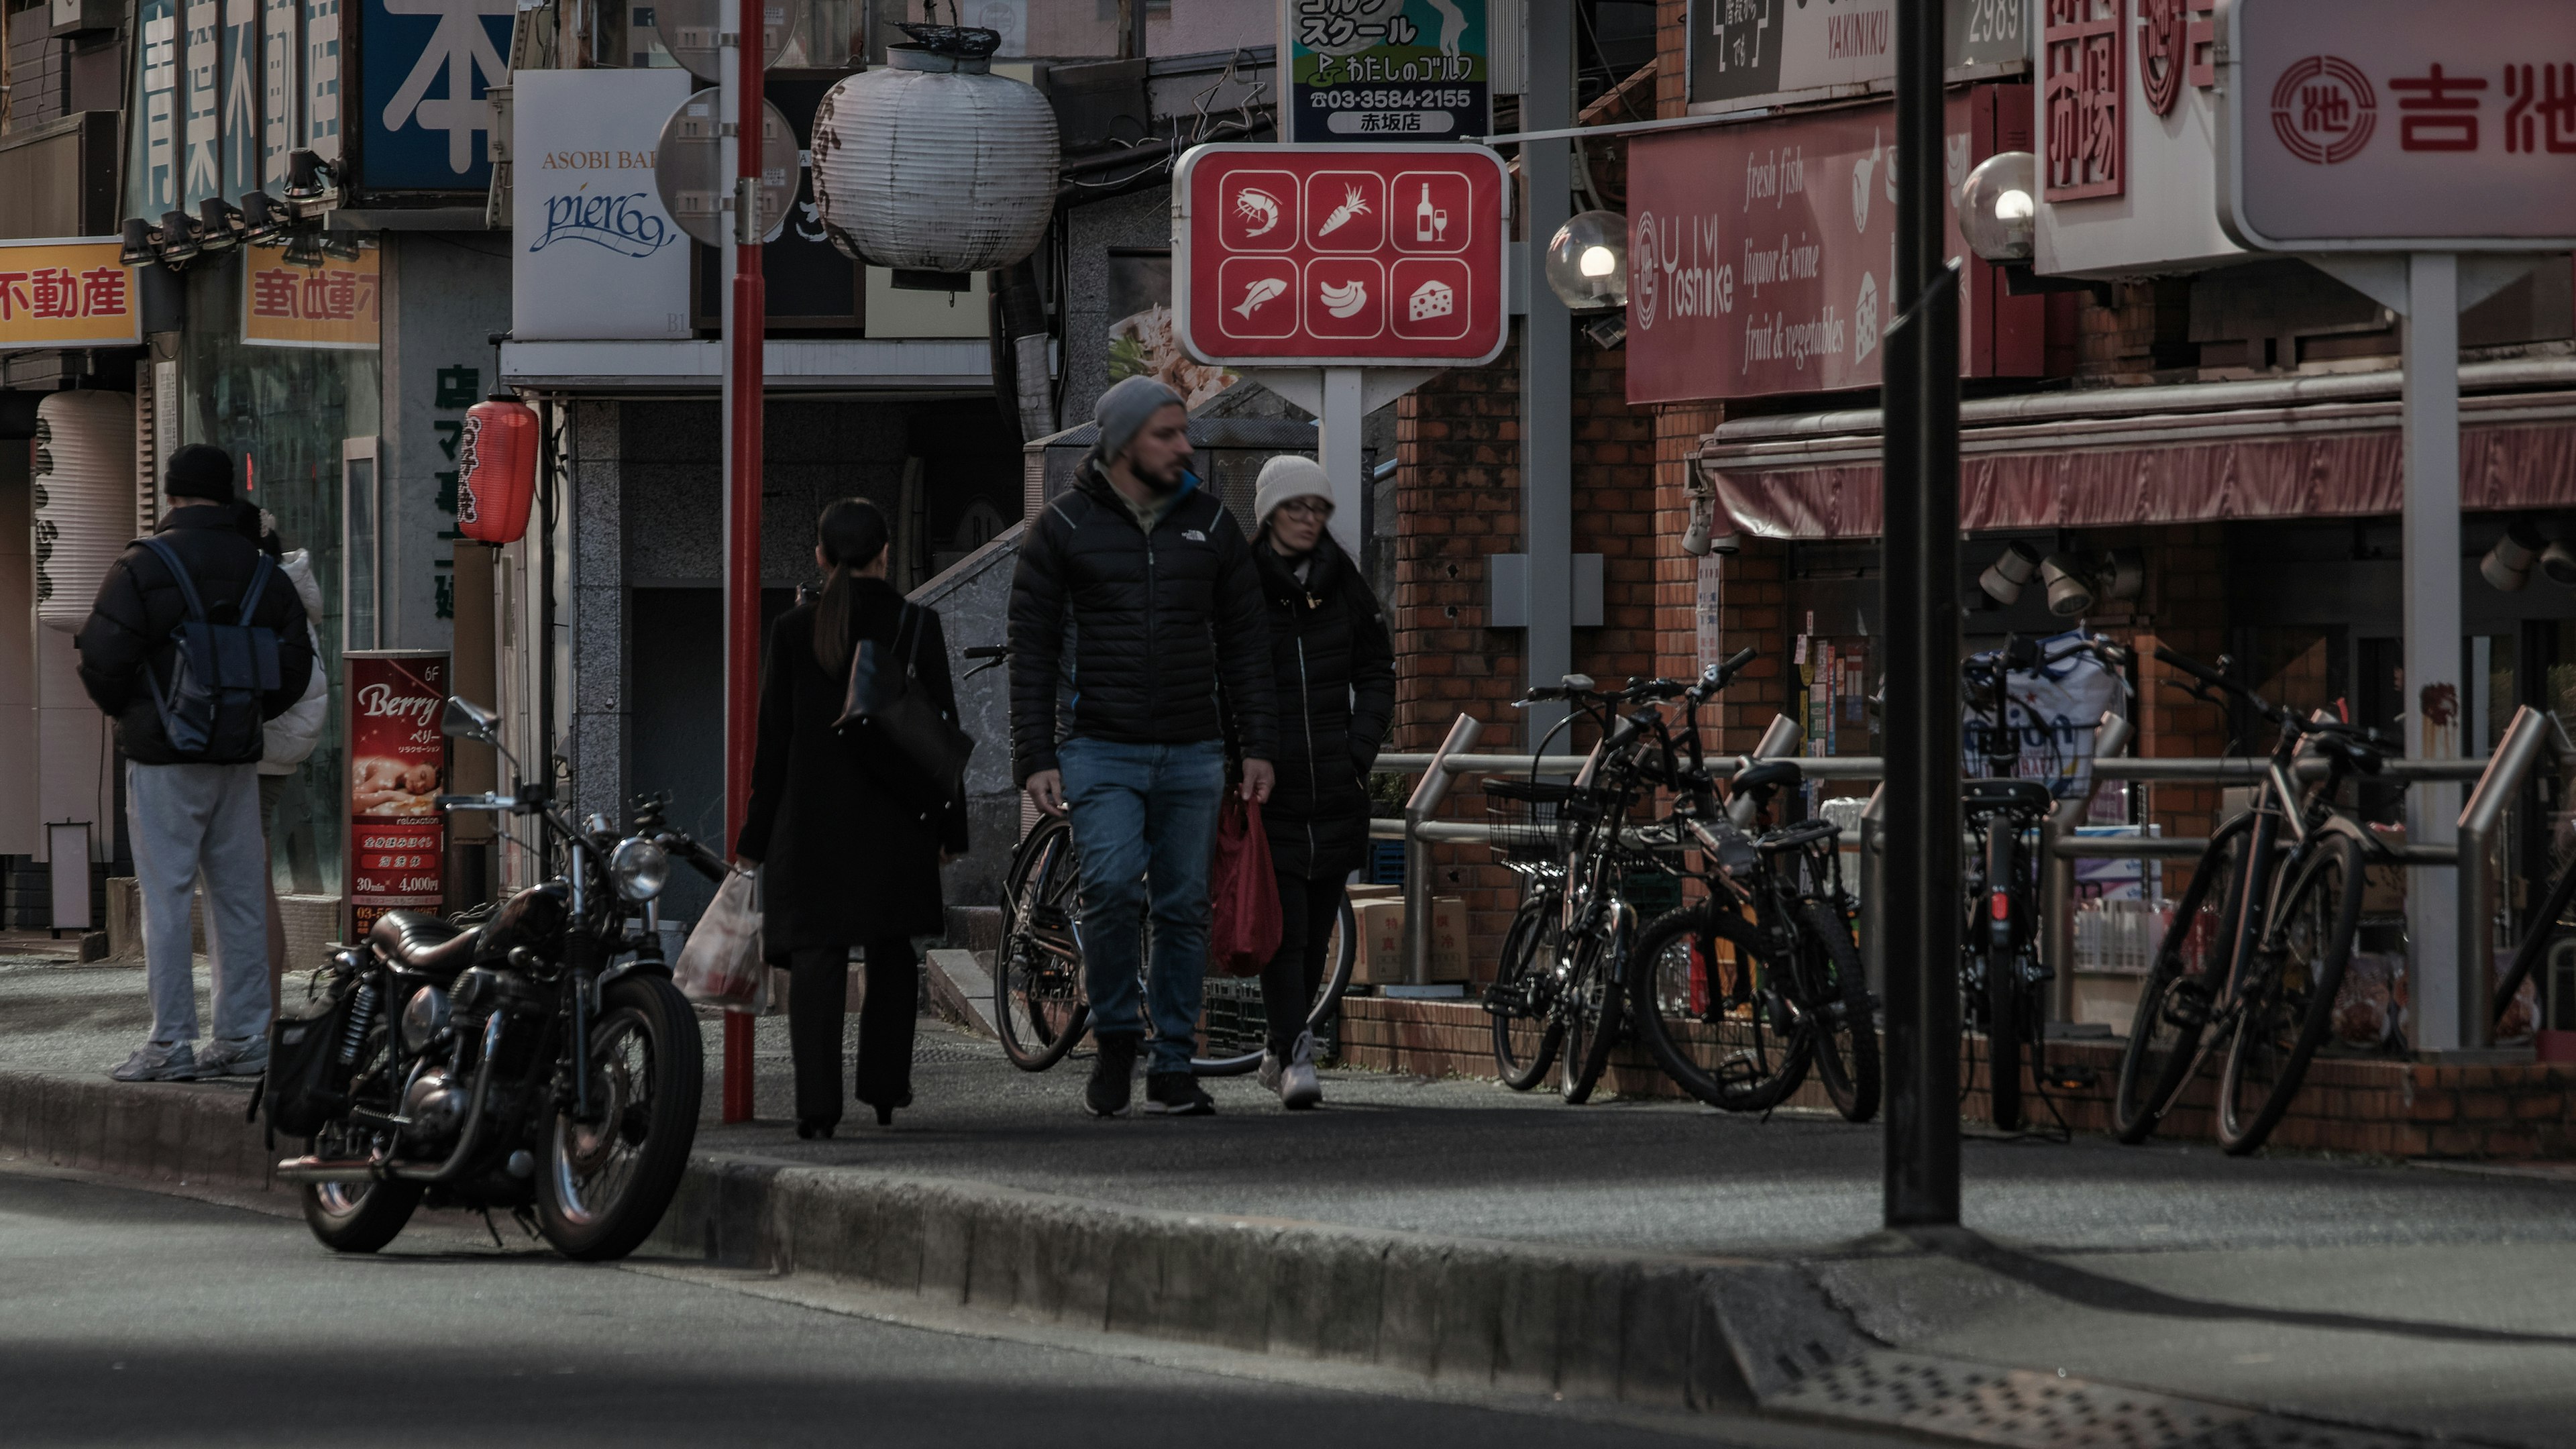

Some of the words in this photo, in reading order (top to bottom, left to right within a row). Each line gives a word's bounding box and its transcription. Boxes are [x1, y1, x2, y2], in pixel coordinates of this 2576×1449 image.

[1301, 15, 1418, 48] スクール
[1828, 9, 1888, 60] YAKINIKU
[1345, 55, 1474, 82] わたしのゴルフ
[1360, 113, 1421, 131] 赤坂店
[541, 151, 610, 170] ASOBI
[1744, 152, 1776, 213] fresh
[1778, 146, 1803, 209] fish
[1744, 237, 1778, 298] liquor
[1779, 233, 1790, 282] &
[1792, 231, 1819, 279] wine
[1743, 312, 1773, 376] fruit
[1774, 311, 1783, 360] &
[1784, 305, 1845, 370] vegetables
[425, 665, 439, 682] 6F
[358, 683, 440, 727] Berry
